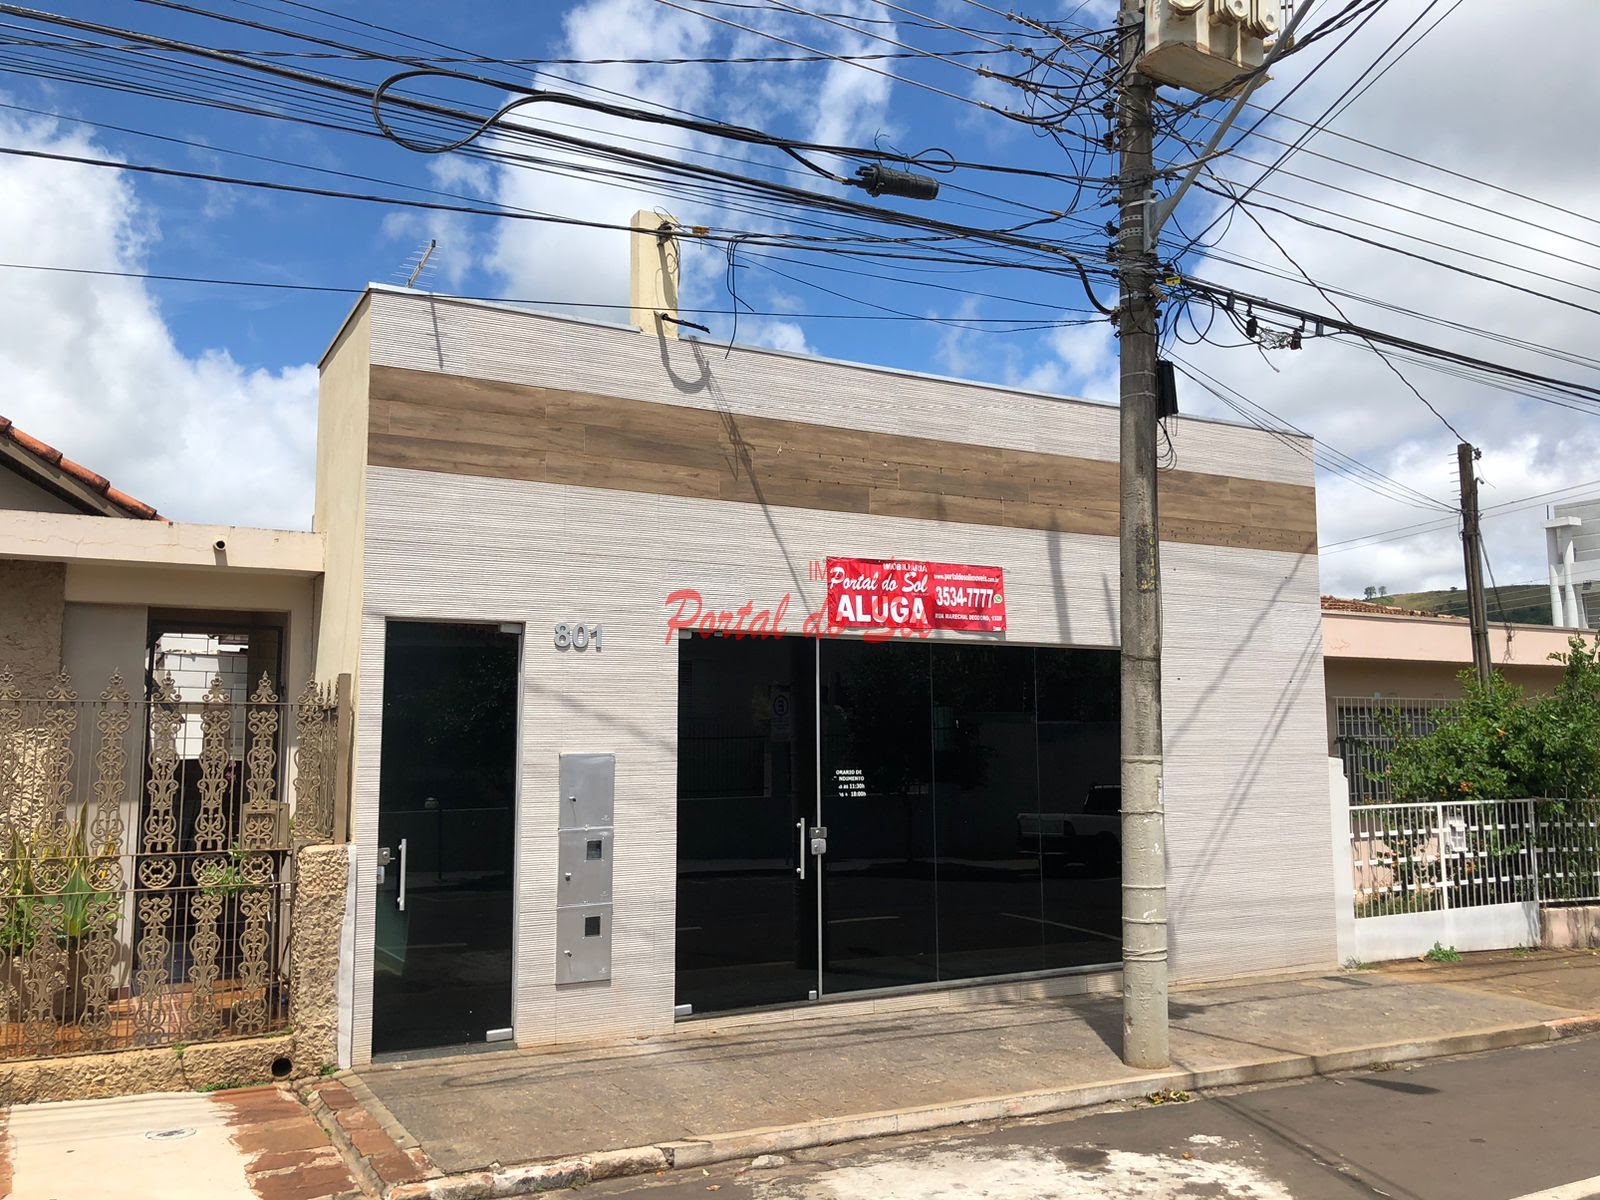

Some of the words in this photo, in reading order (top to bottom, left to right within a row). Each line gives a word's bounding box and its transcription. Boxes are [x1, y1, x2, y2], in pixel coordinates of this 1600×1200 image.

[830, 566, 879, 590] Portal
[881, 573, 898, 592] do
[901, 571, 929, 593] Sol
[835, 594, 929, 624] ALUGA
[935, 586, 994, 608] 3534-7777
[554, 623, 602, 651] 801
